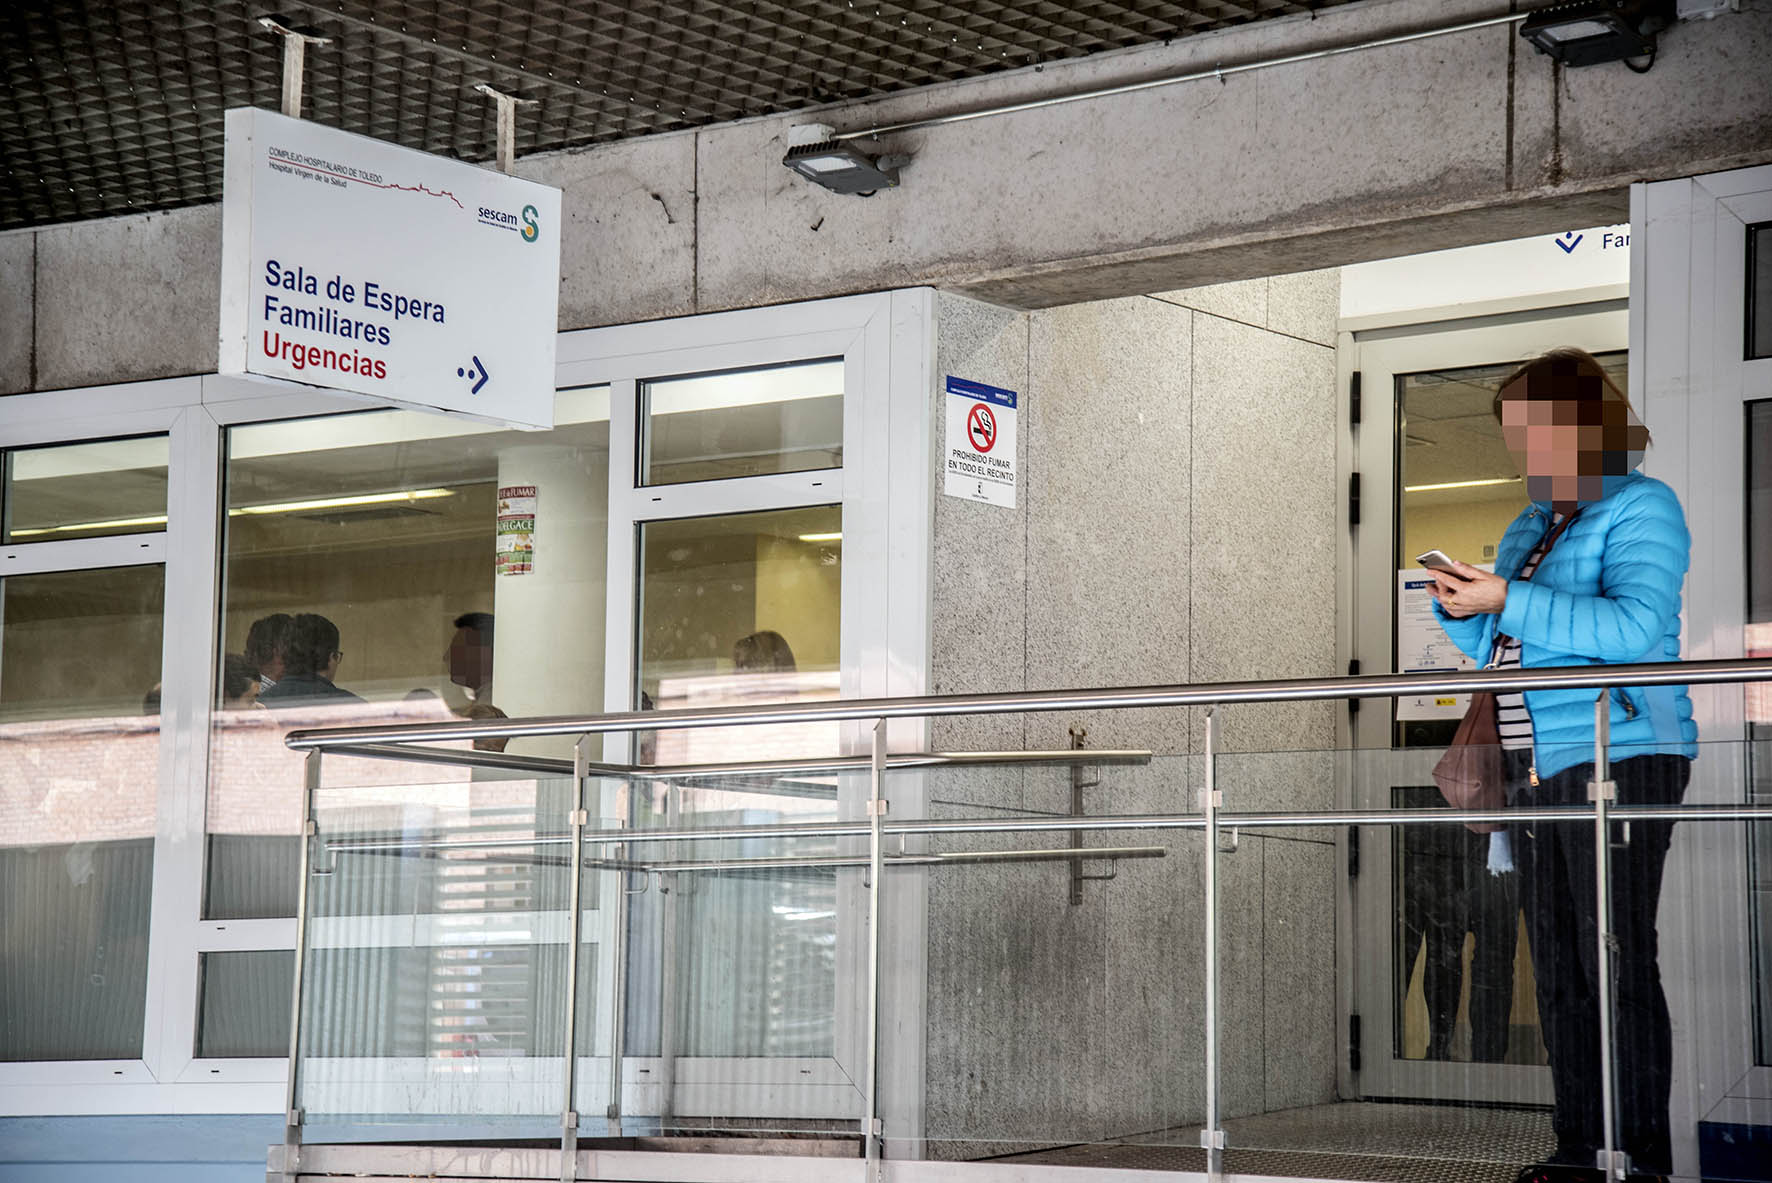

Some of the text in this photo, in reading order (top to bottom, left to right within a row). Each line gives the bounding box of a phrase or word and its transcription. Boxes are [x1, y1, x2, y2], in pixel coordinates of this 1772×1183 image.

[269, 146, 383, 183] COMPLEJO HOSPITALARIO DE TOLEDO
[269, 160, 347, 188] Hospital Virgen de la Salud
[478, 206, 518, 226] sescam
[265, 260, 445, 324] Sala de Espera
[264, 294, 391, 346] Familiares
[263, 330, 387, 380] Urgencias
[948, 459, 957, 469] EN
[959, 461, 977, 473] TODO
[977, 466, 986, 476] EL
[987, 467, 1014, 482] RECINTO
[952, 449, 1010, 469] PROHIBIDO FUMAR
[510, 487, 535, 497] FUMAR
